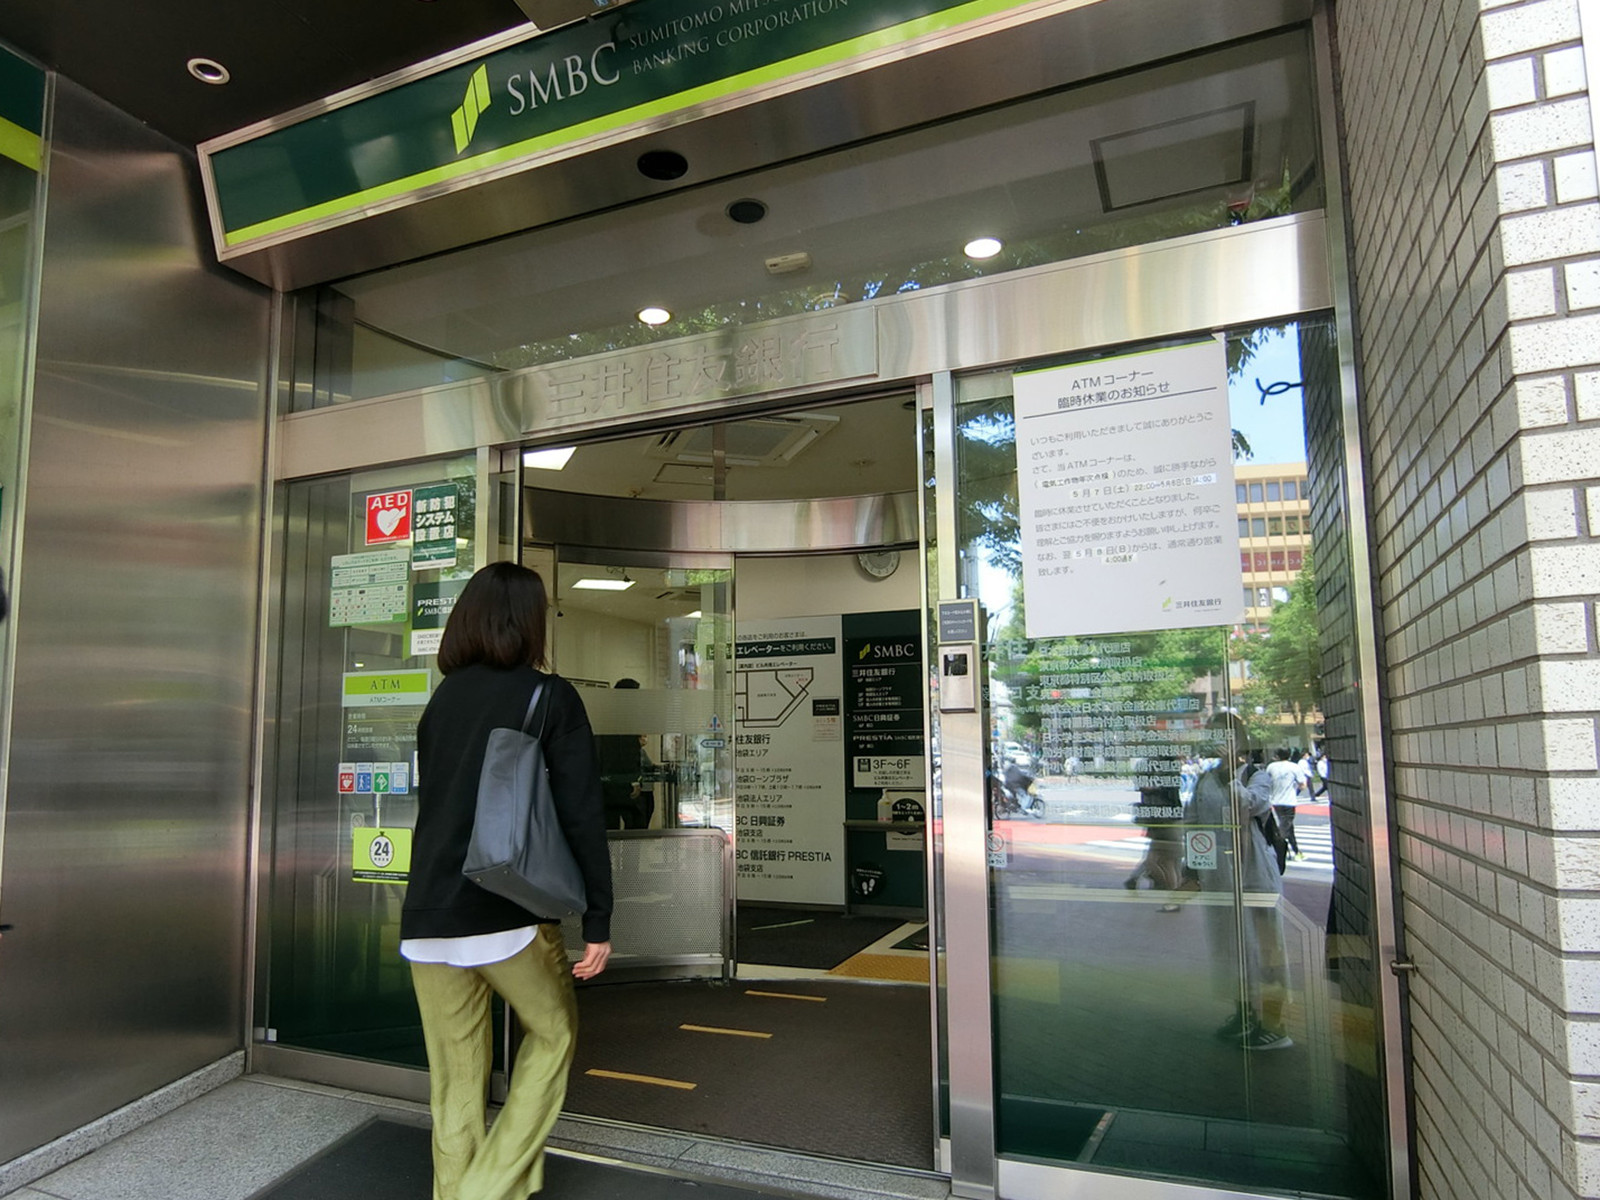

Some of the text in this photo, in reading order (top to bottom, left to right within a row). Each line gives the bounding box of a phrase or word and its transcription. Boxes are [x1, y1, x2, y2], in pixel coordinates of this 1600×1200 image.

[629, 5, 724, 50] SUMITOMO
[632, 36, 710, 75] BANKING
[506, 42, 621, 117] SMBC
[546, 323, 840, 420] 三井住友銀行
[1071, 370, 1154, 391] ATMコーナー
[1057, 381, 1170, 409] 臨時休業のお知らせ
[1029, 411, 1214, 447] いつもご利用いただきまして誠にありがとうご
[1031, 449, 1070, 461] ざいます。
[1032, 454, 1137, 475] さて、当ATMコーナーは、
[370, 493, 409, 510] AED
[415, 495, 455, 513] 新防犯
[1034, 493, 1200, 518] 臨時に休業させていただくこととなりました。
[415, 511, 455, 528] システム
[1175, 598, 1222, 609] 三井住友銀行
[873, 644, 915, 659] SMBC
[852, 668, 896, 678] 三井住友銀行
[370, 679, 401, 690] ATM
[750, 816, 786, 827] 日興証券
[374, 841, 390, 856] 24
[750, 850, 787, 861] 信託銀行
[788, 851, 832, 862] PRESTIA
